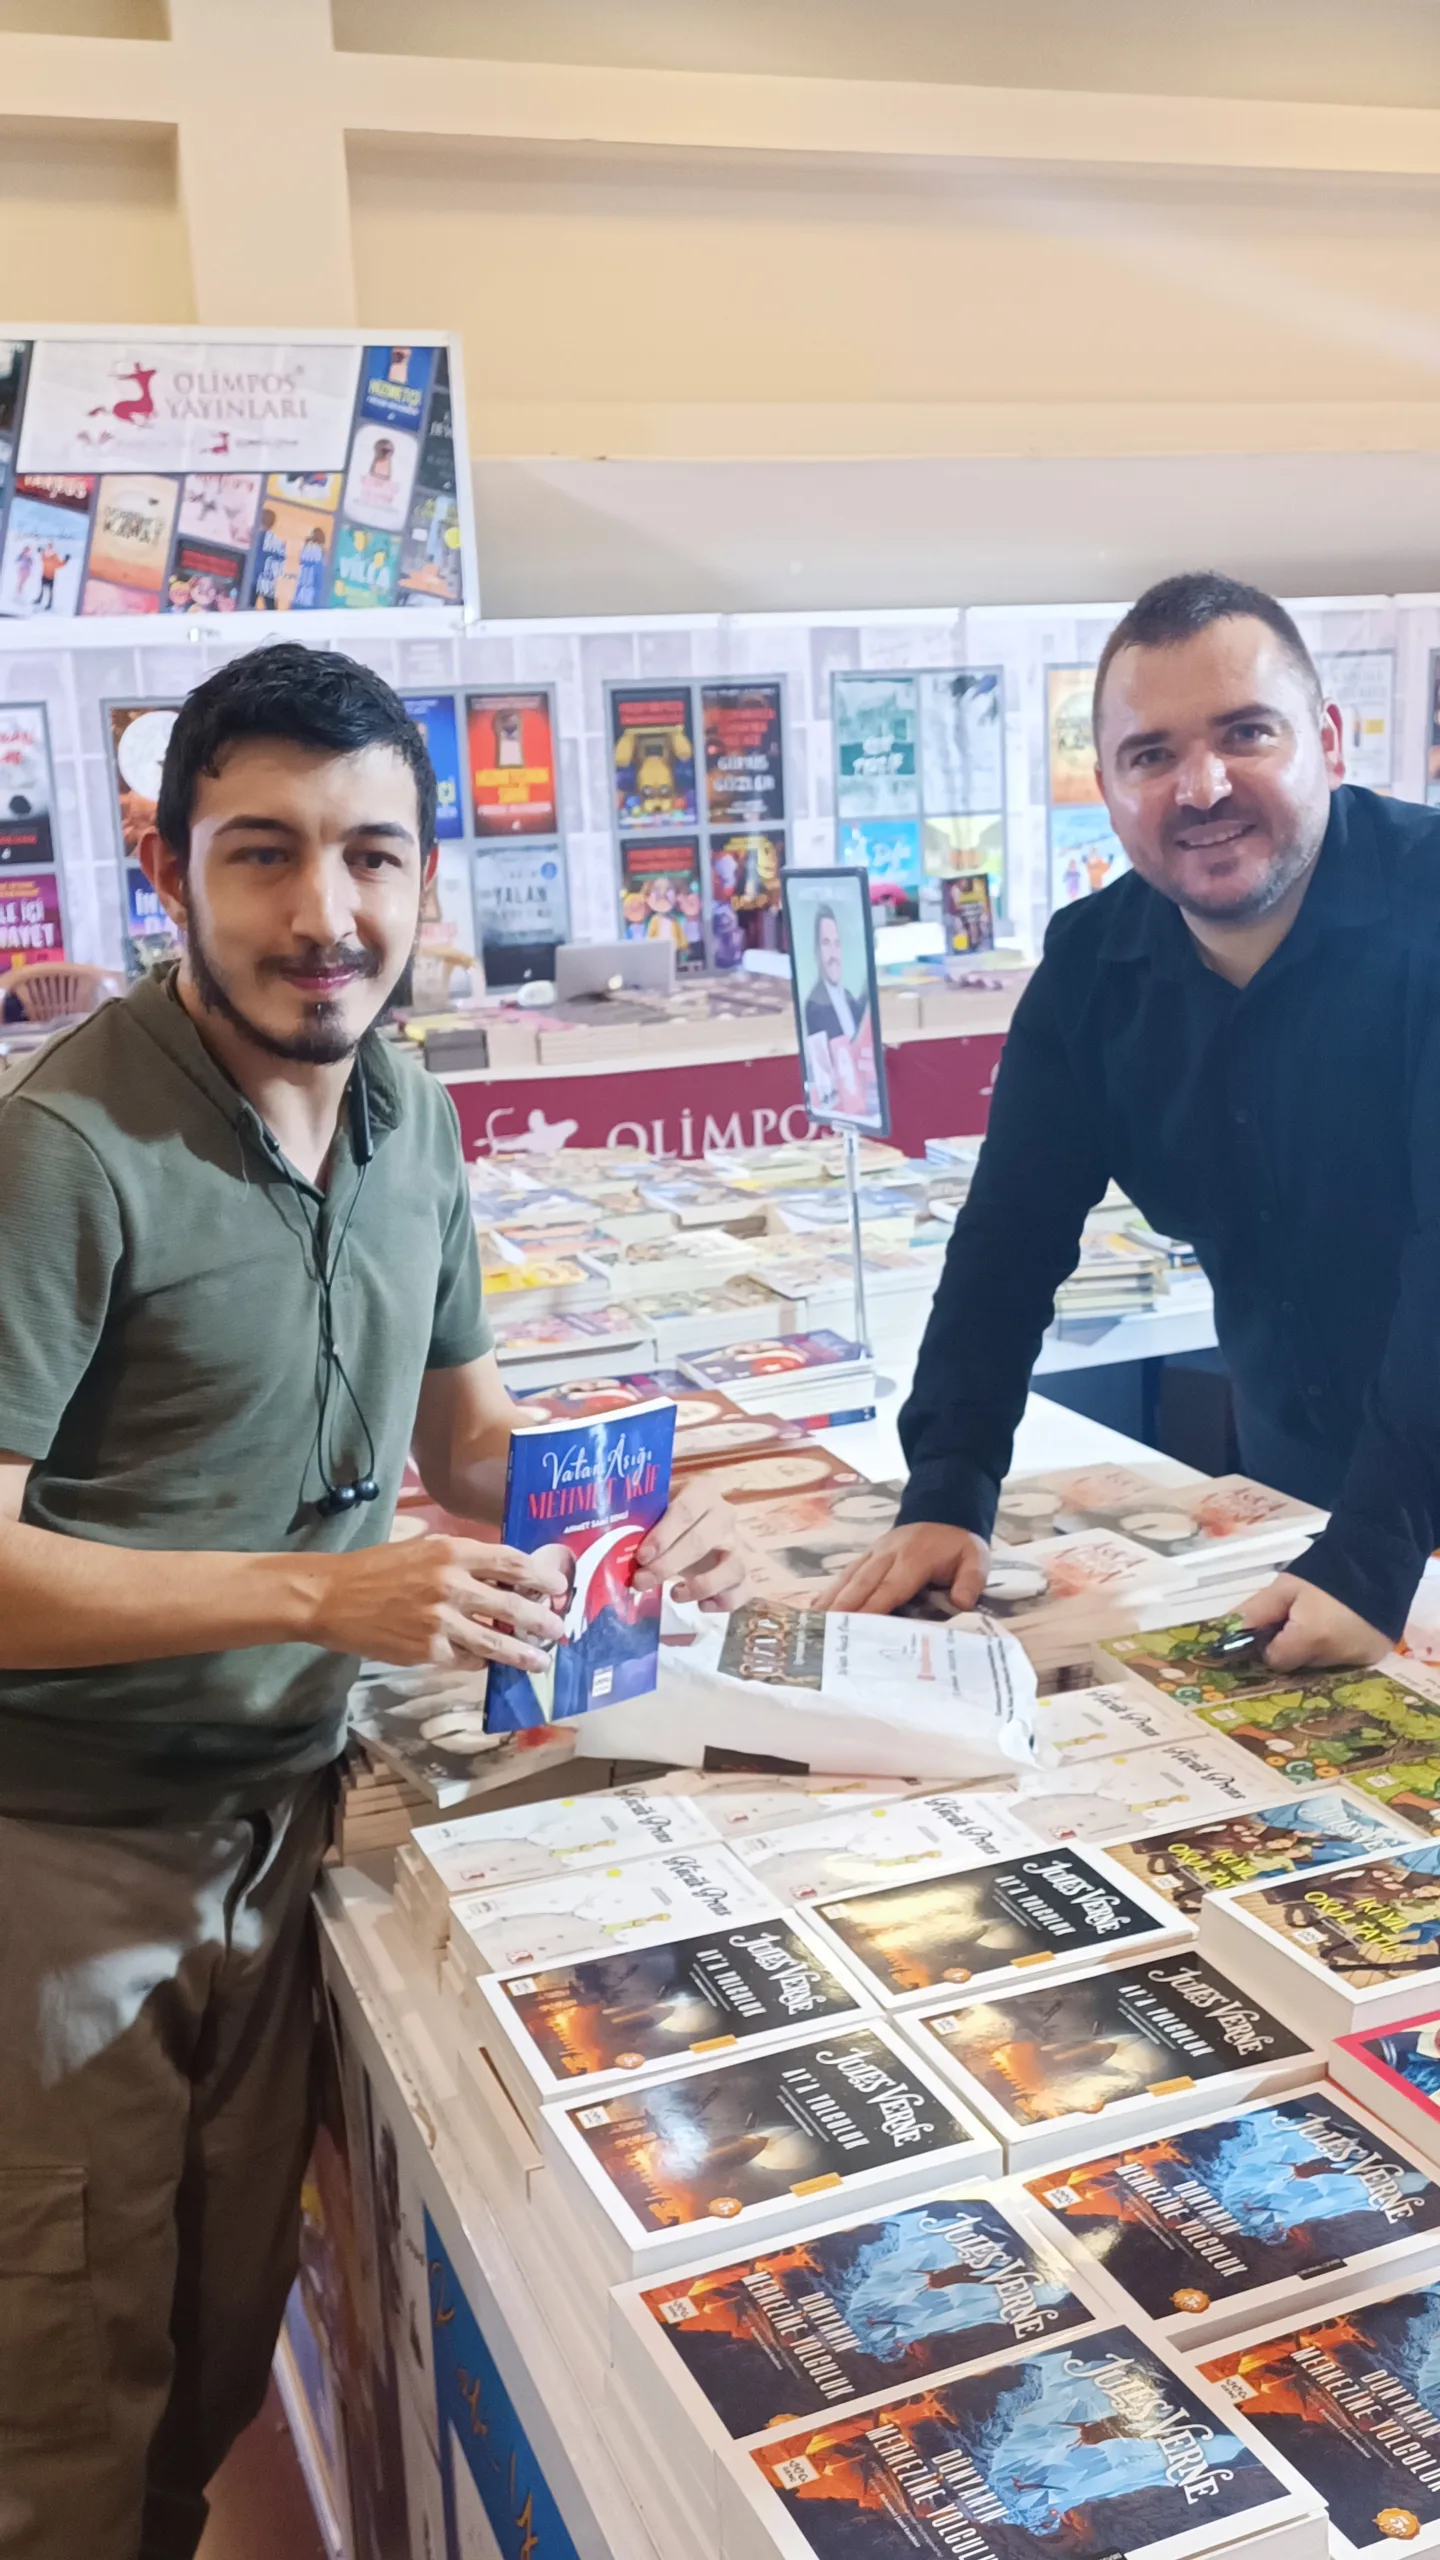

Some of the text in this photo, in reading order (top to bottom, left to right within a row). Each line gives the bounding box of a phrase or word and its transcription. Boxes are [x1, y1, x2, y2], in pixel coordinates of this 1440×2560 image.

[165, 396, 308, 419] YAYINLARI
[606, 1104, 838, 1160] OLİMPO
[542, 1444, 604, 1490] Vatan
[1200, 1772, 1247, 1800] Prens
[957, 1826, 1001, 1855] Prens
[1168, 1843, 1211, 1870] OKUL
[691, 1887, 732, 1916] Prens
[1017, 1894, 1076, 1936] YOLCULUK
[1022, 1860, 1095, 1896] JULES
[1070, 1888, 1131, 1935] VERNE
[1304, 1891, 1356, 1925] OKUL
[714, 1970, 767, 2017] YOLCULUK
[729, 1932, 799, 1971] JULES
[768, 1962, 827, 2015] VERNE
[1146, 2007, 1215, 2057] YOLCULUK
[1148, 1967, 1230, 2008] JULES
[1204, 2000, 1275, 2056] VERNE
[805, 2093, 870, 2150] YOLCULUK
[816, 2047, 935, 2148] JULES VERNE
[1271, 2112, 1425, 2225] JULES VERNE
[918, 2212, 1059, 2340] JULES VERNE
[1175, 2218, 1248, 2278] YOLCULUK
[789, 2333, 856, 2401] YOLCULUK
[1063, 2353, 1174, 2421] JULES
[1140, 2406, 1234, 2505] VERNE
